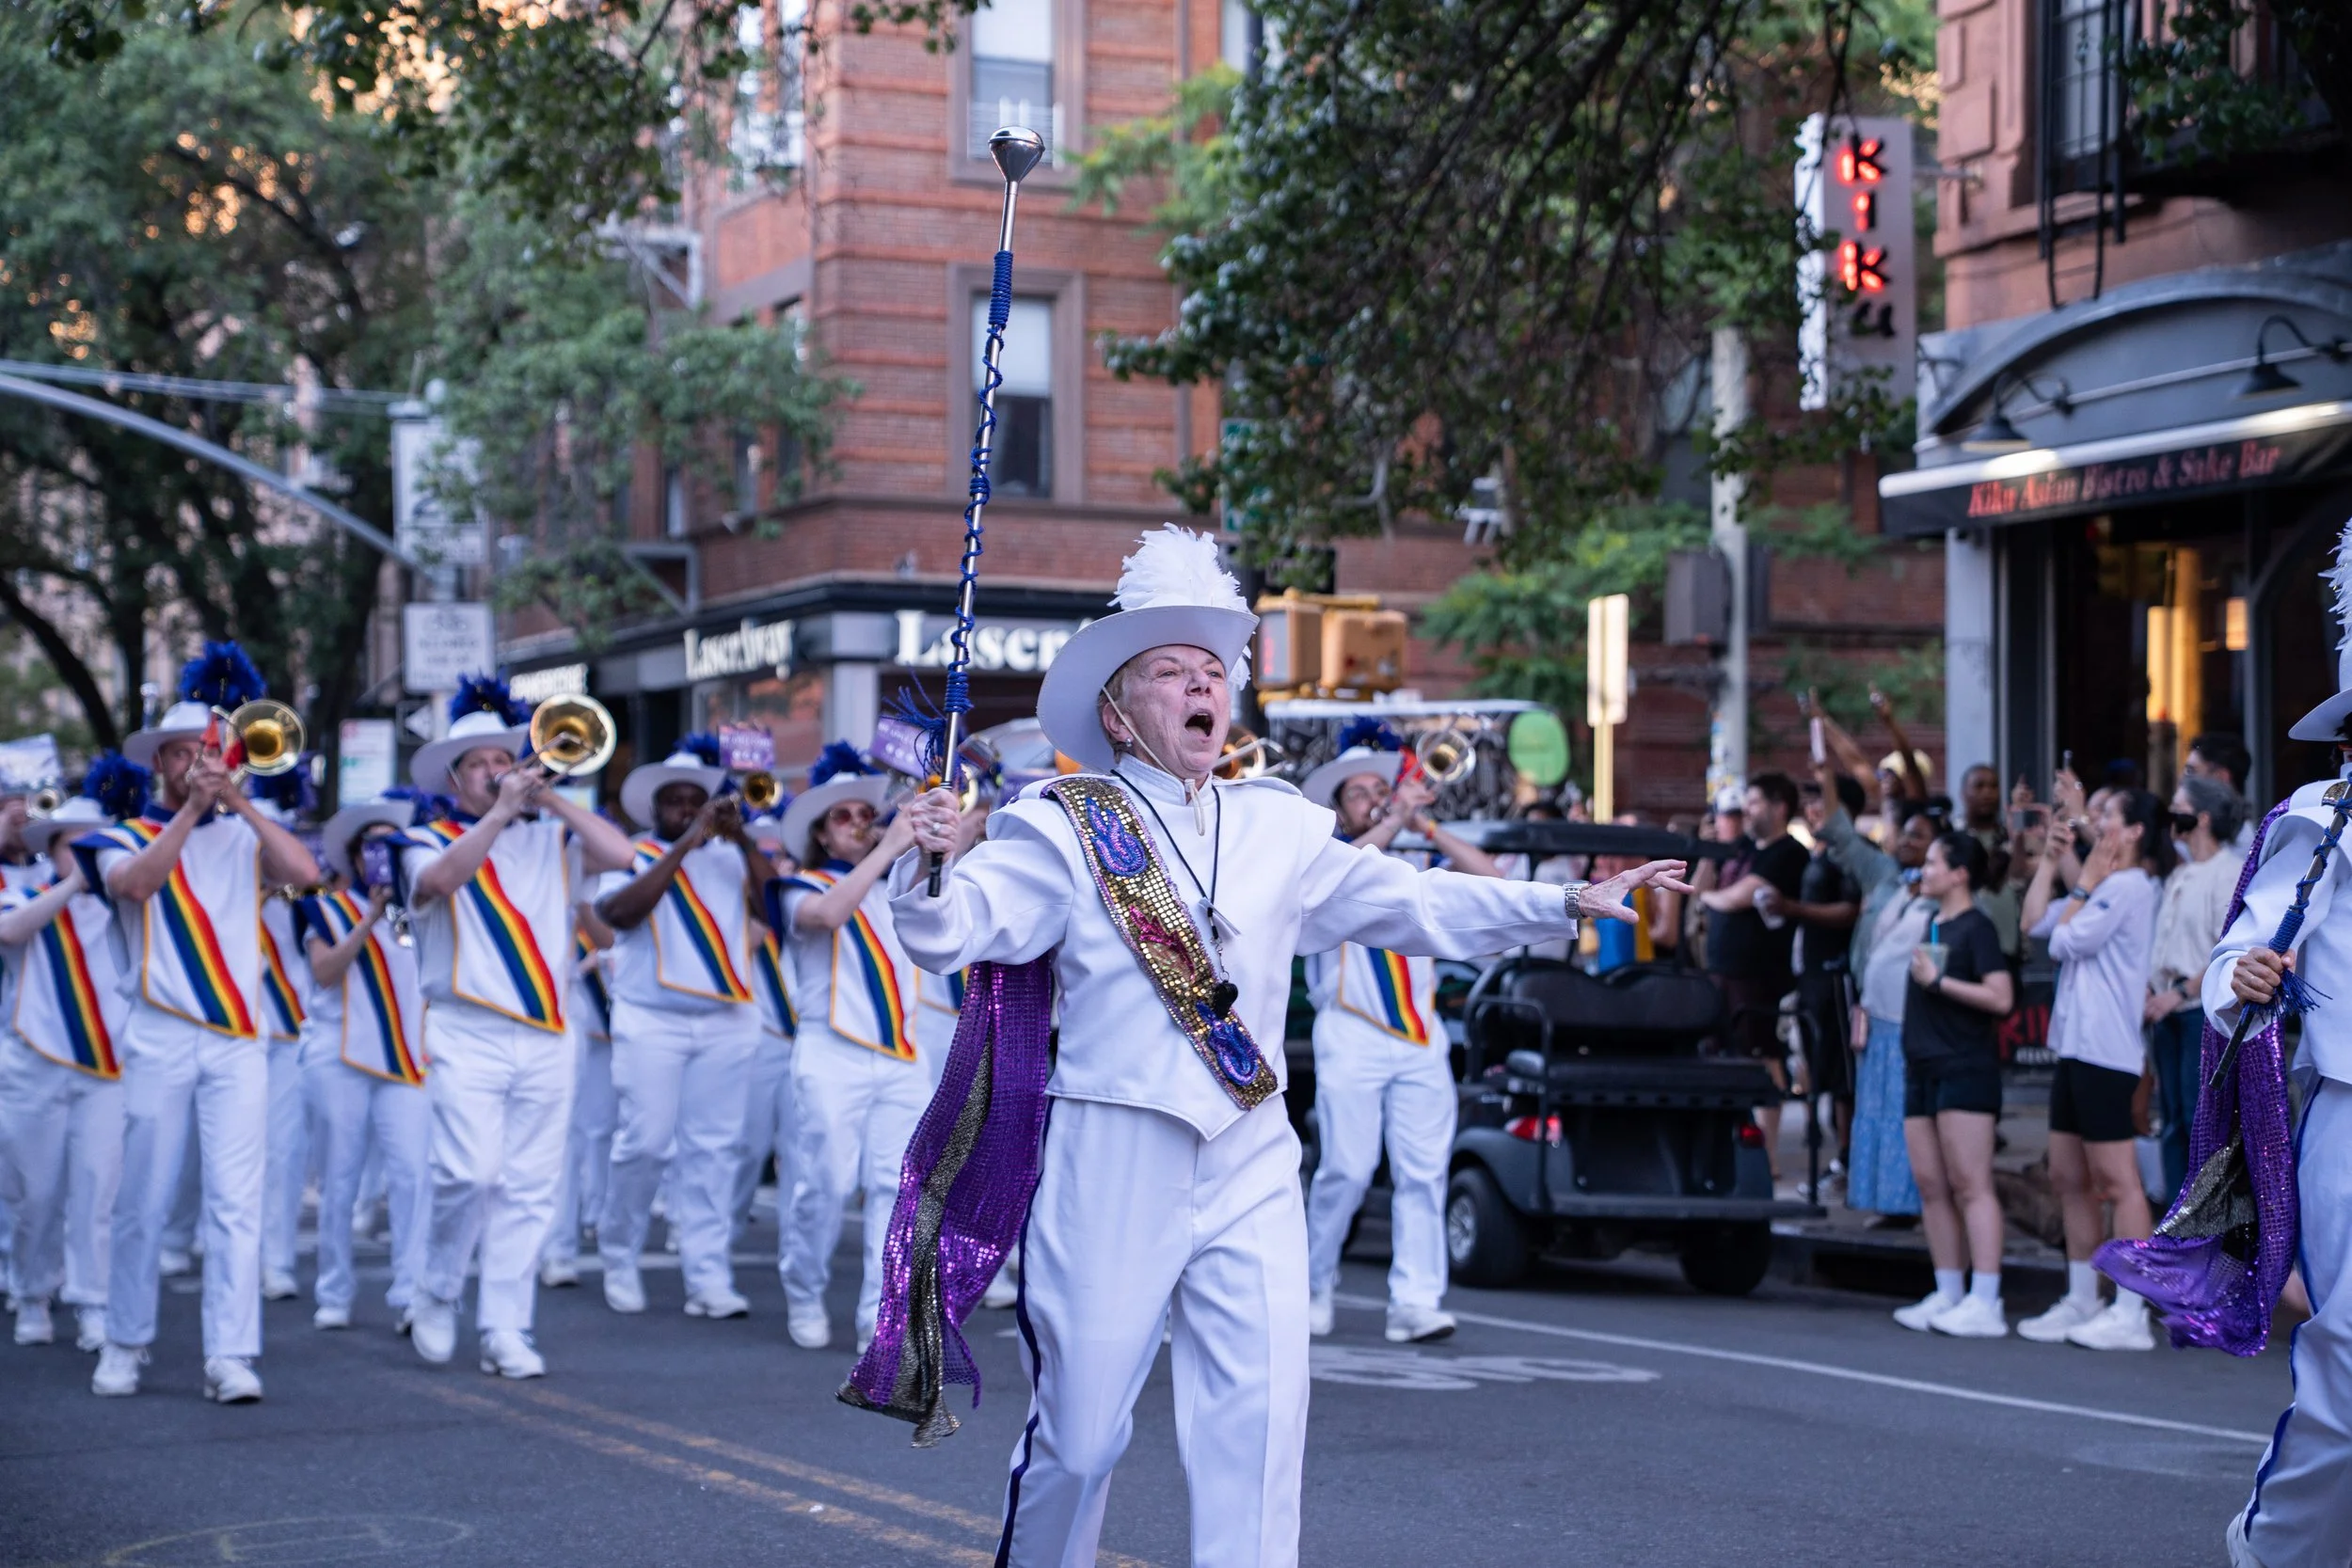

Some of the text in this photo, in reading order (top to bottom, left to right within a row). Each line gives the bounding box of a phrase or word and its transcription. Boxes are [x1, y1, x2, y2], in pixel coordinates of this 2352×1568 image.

[2020, 472, 2077, 510] Asian
[2238, 440, 2281, 479] Bar
[896, 610, 1093, 672] Laser
